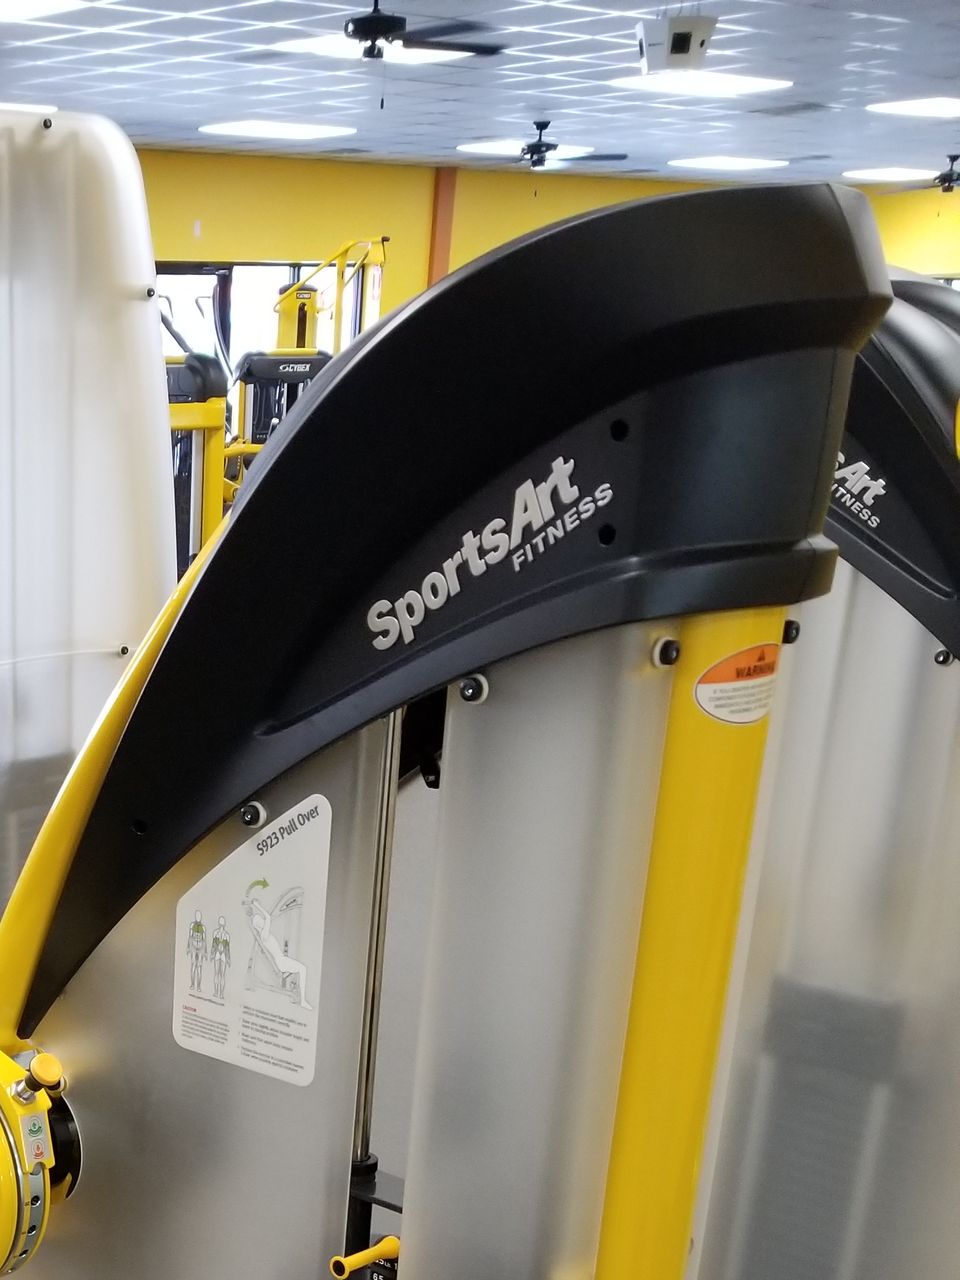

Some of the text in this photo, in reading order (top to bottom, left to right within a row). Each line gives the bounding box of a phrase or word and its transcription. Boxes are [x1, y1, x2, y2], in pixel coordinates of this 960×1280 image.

[511, 483, 614, 573] FITNESS
[831, 481, 881, 529] ITNESS
[367, 456, 580, 651] SportsArt
[256, 805, 320, 857] S923 Pull Over
